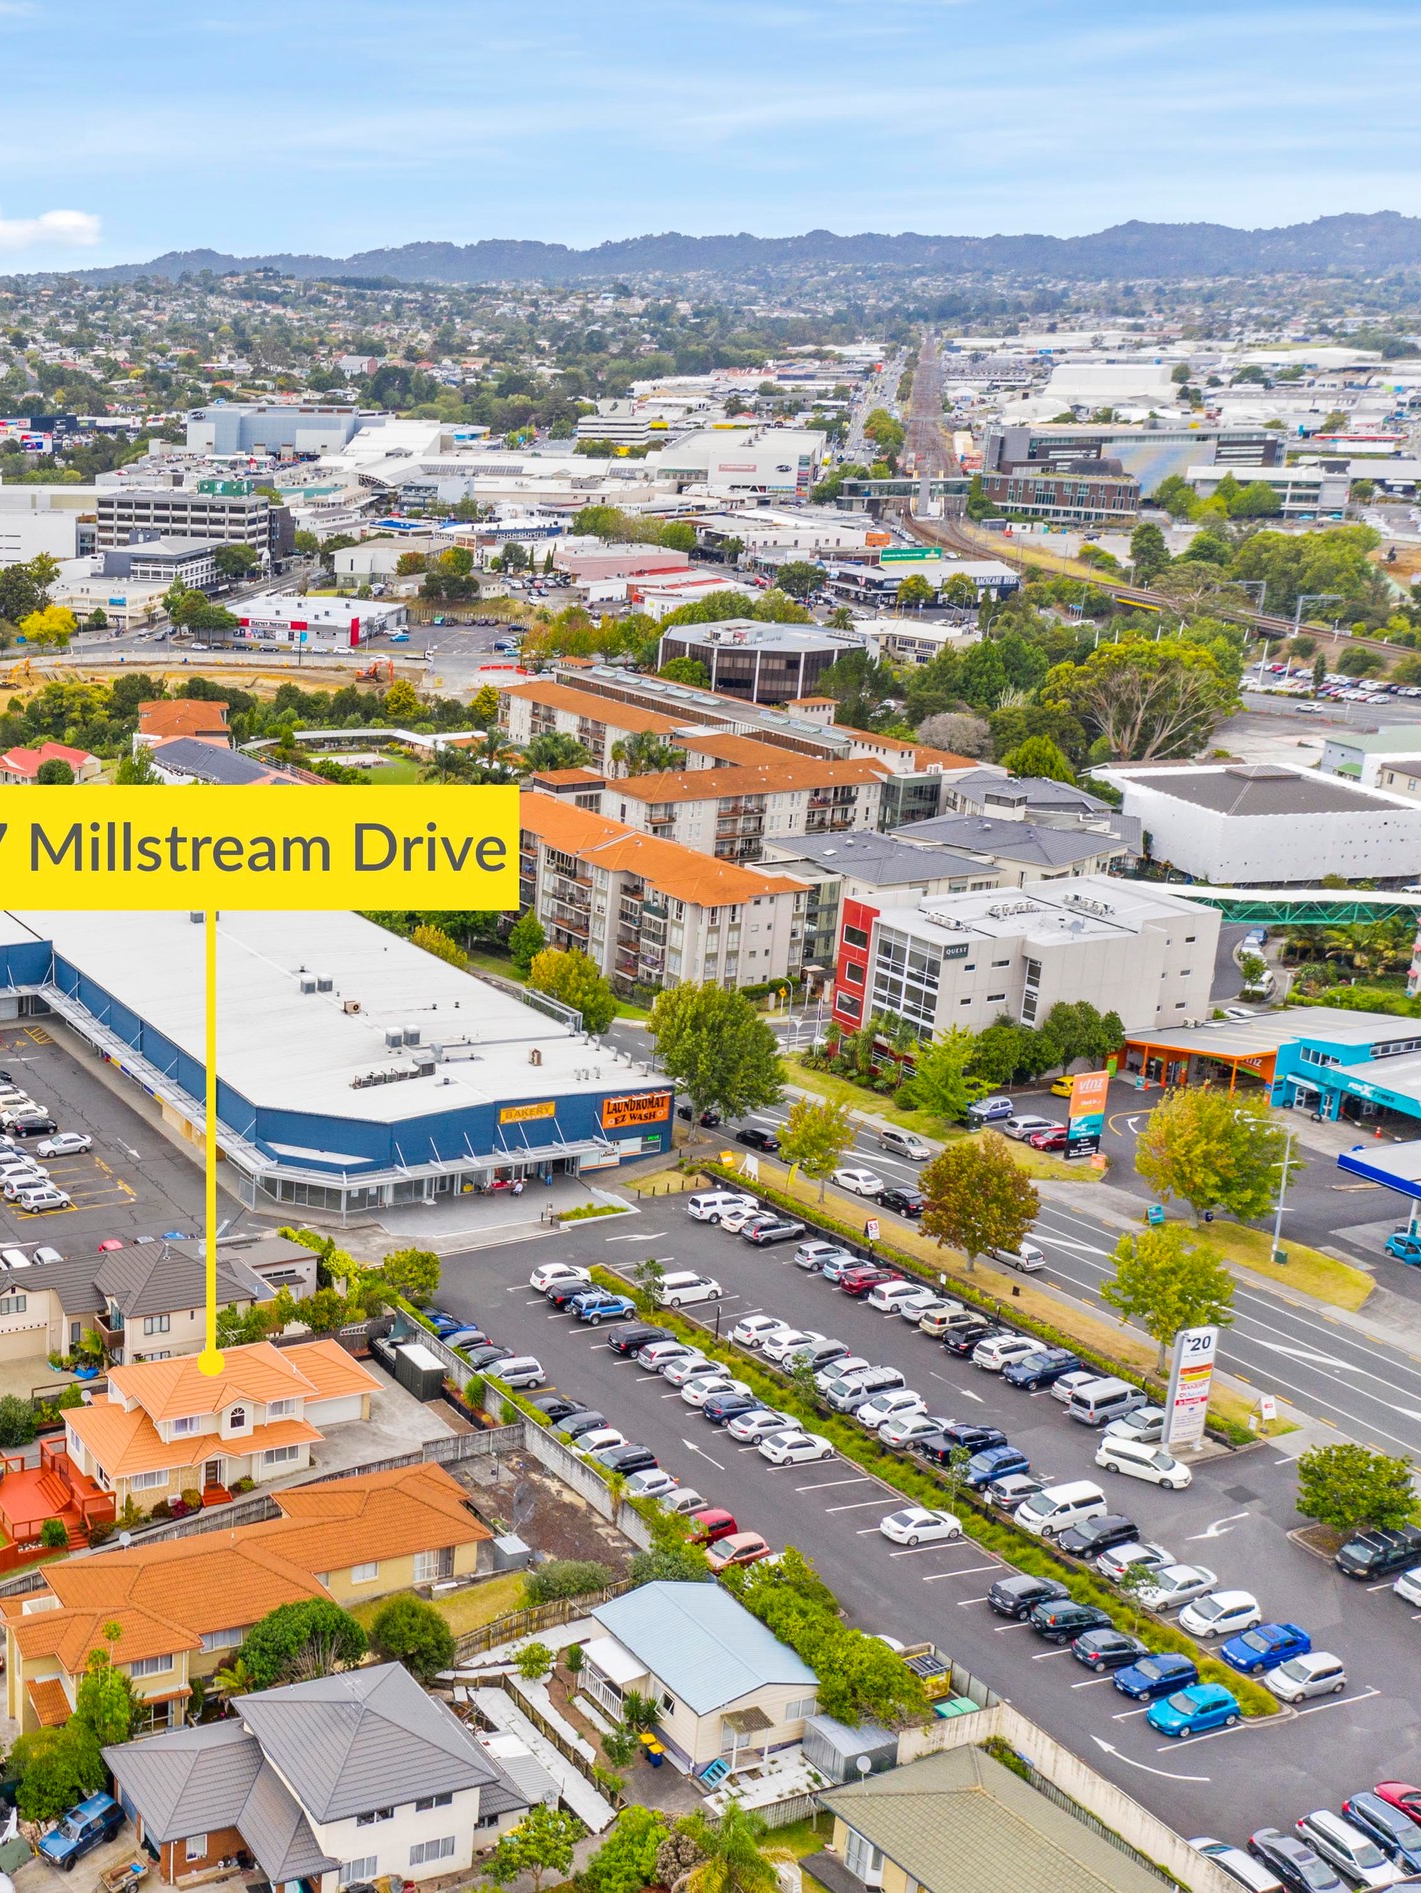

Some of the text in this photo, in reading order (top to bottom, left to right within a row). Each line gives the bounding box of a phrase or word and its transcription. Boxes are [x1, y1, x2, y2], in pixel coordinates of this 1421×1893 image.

[946, 947, 967, 955] QUEST
[1079, 1078, 1104, 1089] vtnz
[505, 1105, 551, 1119] BAKERY
[607, 1096, 666, 1114] LAUNDROMAT
[614, 1111, 656, 1125] EZ WASH
